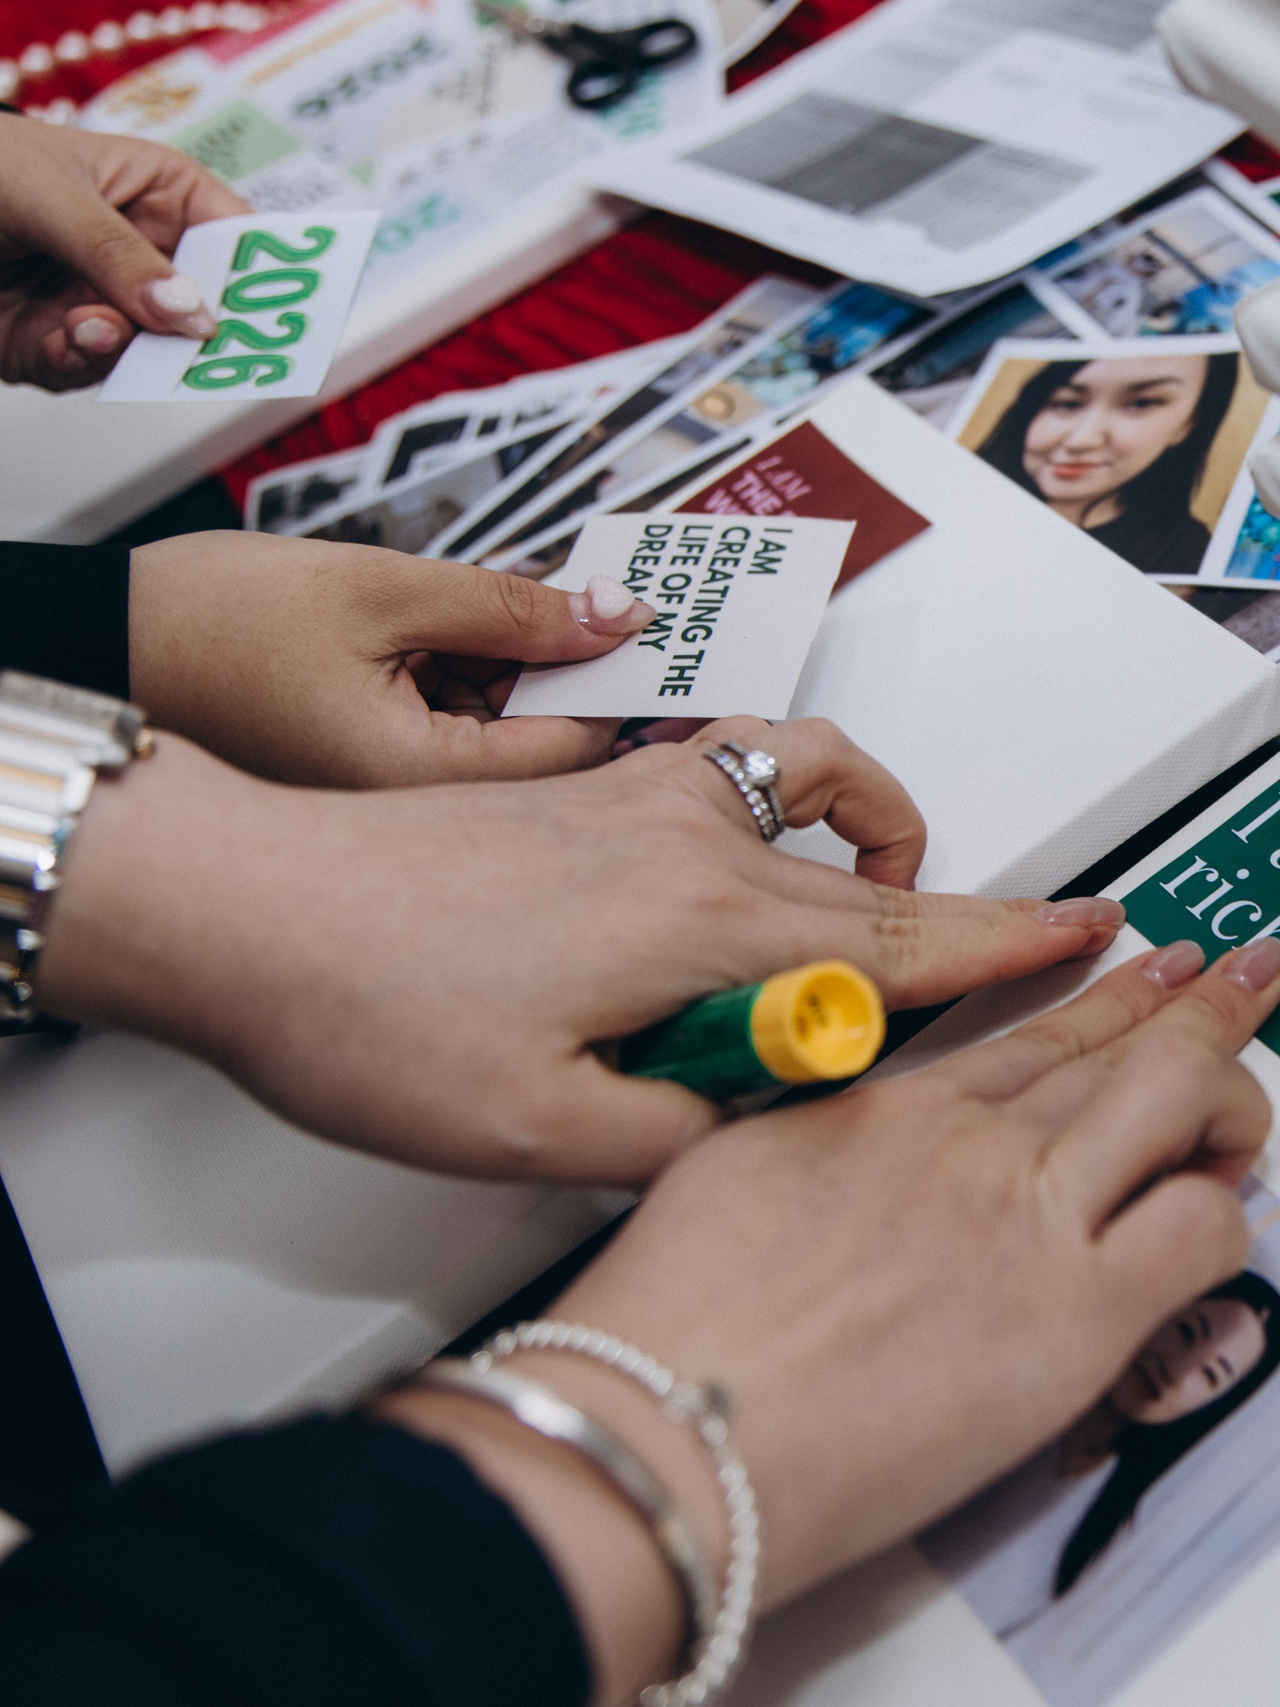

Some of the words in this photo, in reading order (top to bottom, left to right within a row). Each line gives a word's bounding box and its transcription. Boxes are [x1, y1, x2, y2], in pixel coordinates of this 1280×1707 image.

[182, 225, 336, 390] 2026
[755, 455, 783, 471] I
[731, 469, 783, 515] THE
[764, 469, 812, 501] AM
[669, 525, 714, 566] LIFE
[747, 538, 787, 574] AM
[656, 573, 692, 604] OF
[681, 526, 751, 643] CREATING
[637, 612, 678, 651] MY
[658, 650, 705, 696] THE
